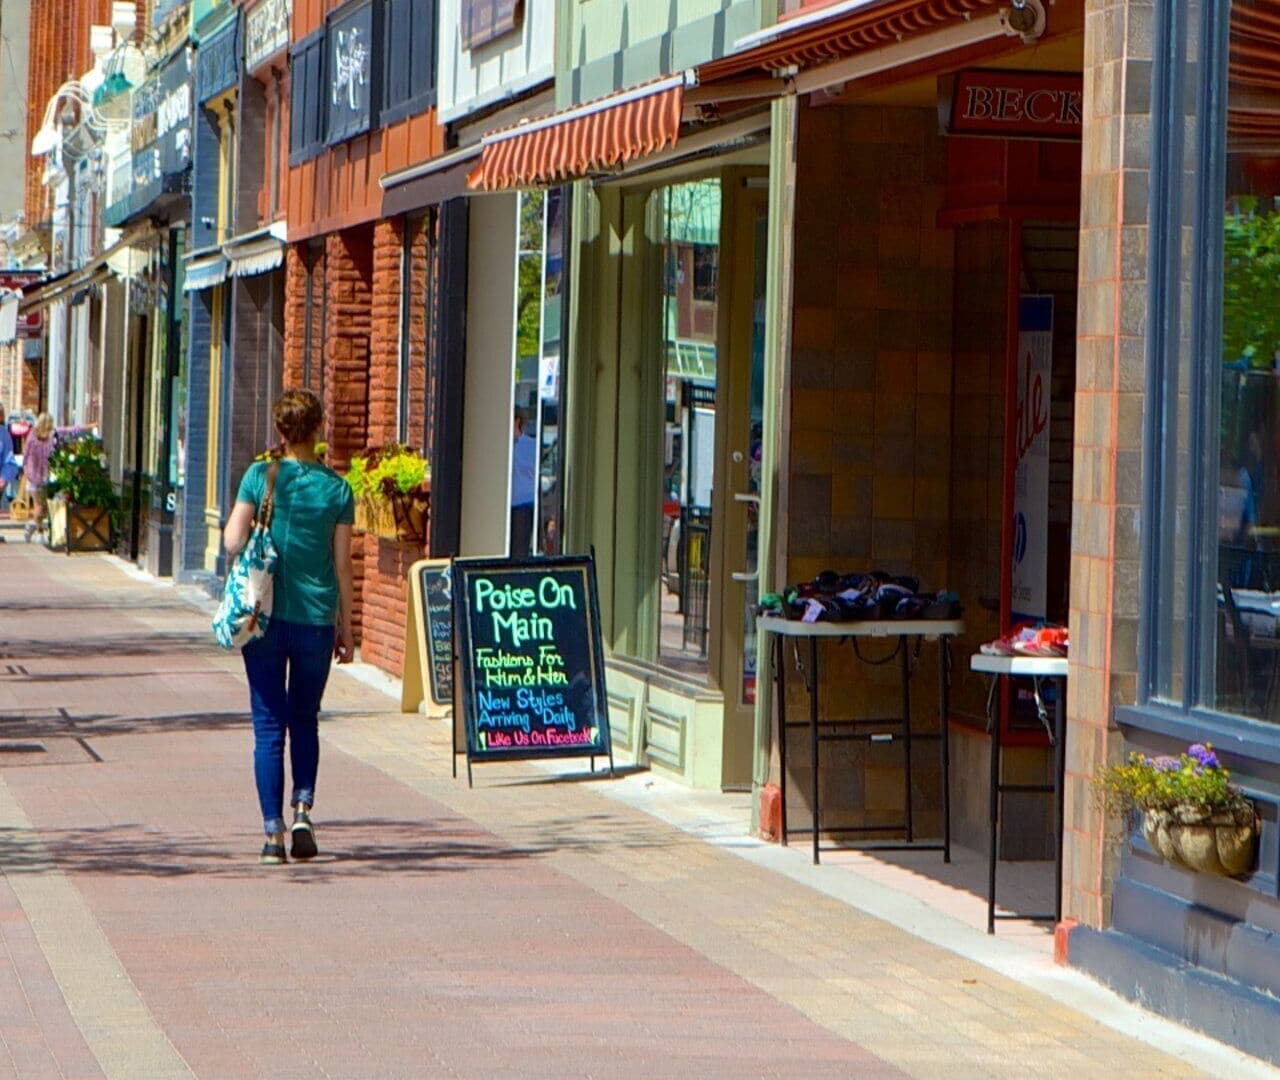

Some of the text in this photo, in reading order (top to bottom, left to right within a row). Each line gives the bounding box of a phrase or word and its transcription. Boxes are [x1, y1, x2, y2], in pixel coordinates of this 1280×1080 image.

[475, 576, 576, 612] Poise On
[491, 610, 554, 647] Main
[475, 647, 534, 668] Fashions
[538, 645, 564, 666] For
[486, 665, 569, 688] Him & Her
[478, 687, 564, 716] New Styles
[478, 705, 576, 734] Arriving Daily
[488, 726, 591, 746] Like Us On Facebook
